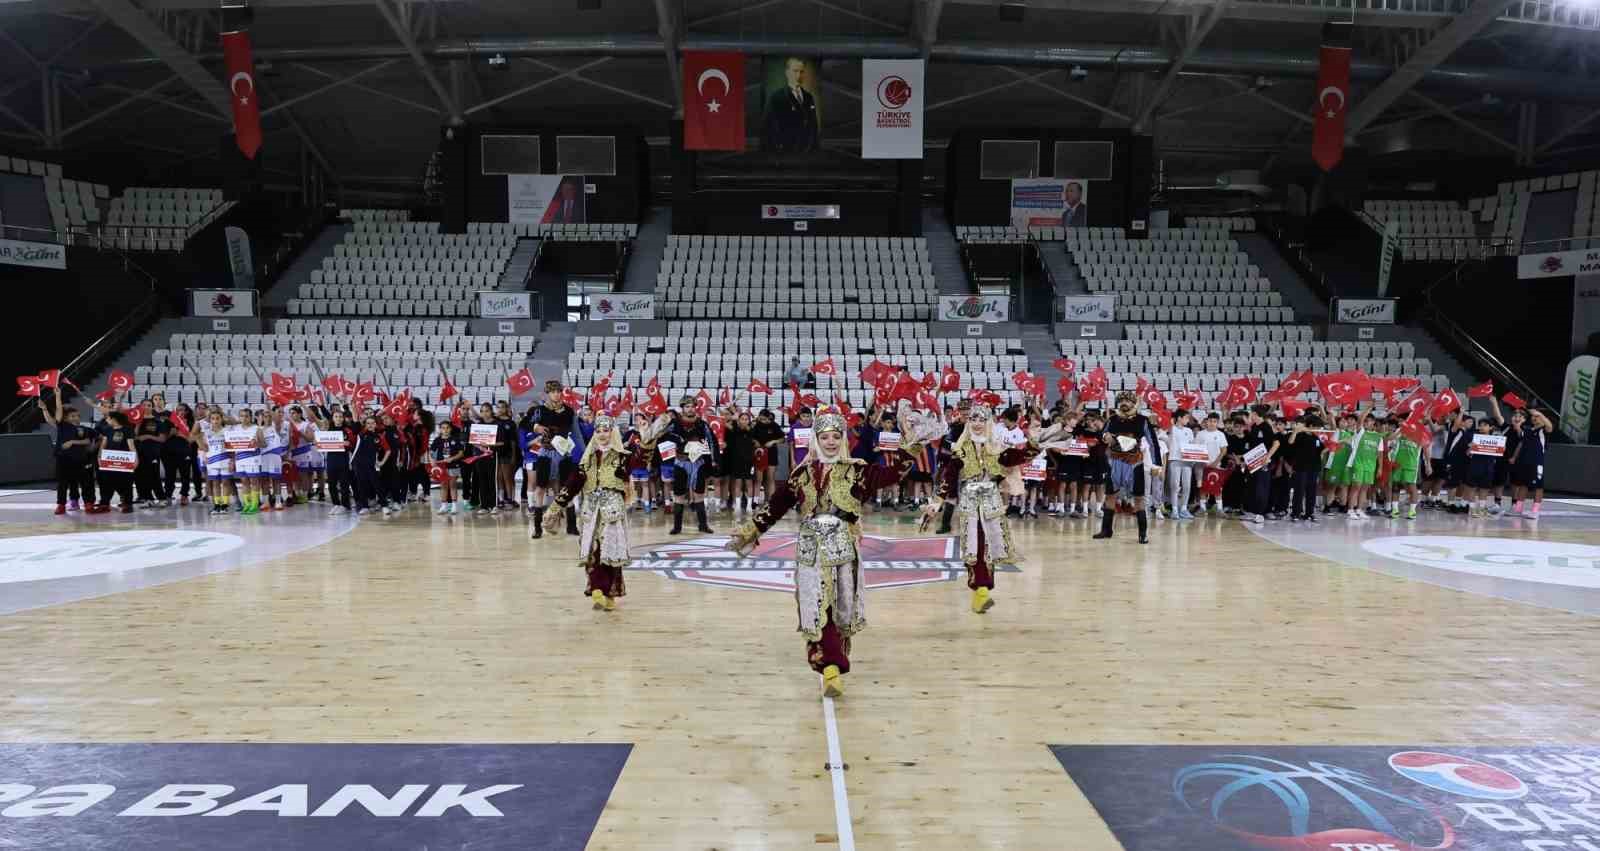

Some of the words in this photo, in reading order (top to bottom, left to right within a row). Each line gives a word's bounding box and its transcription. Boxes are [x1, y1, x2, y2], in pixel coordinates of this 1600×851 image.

[877, 109, 912, 118] TÜRKİYE
[1351, 304, 1386, 319] Glint
[1572, 369, 1593, 418] Glint
[117, 784, 525, 817] BANK
